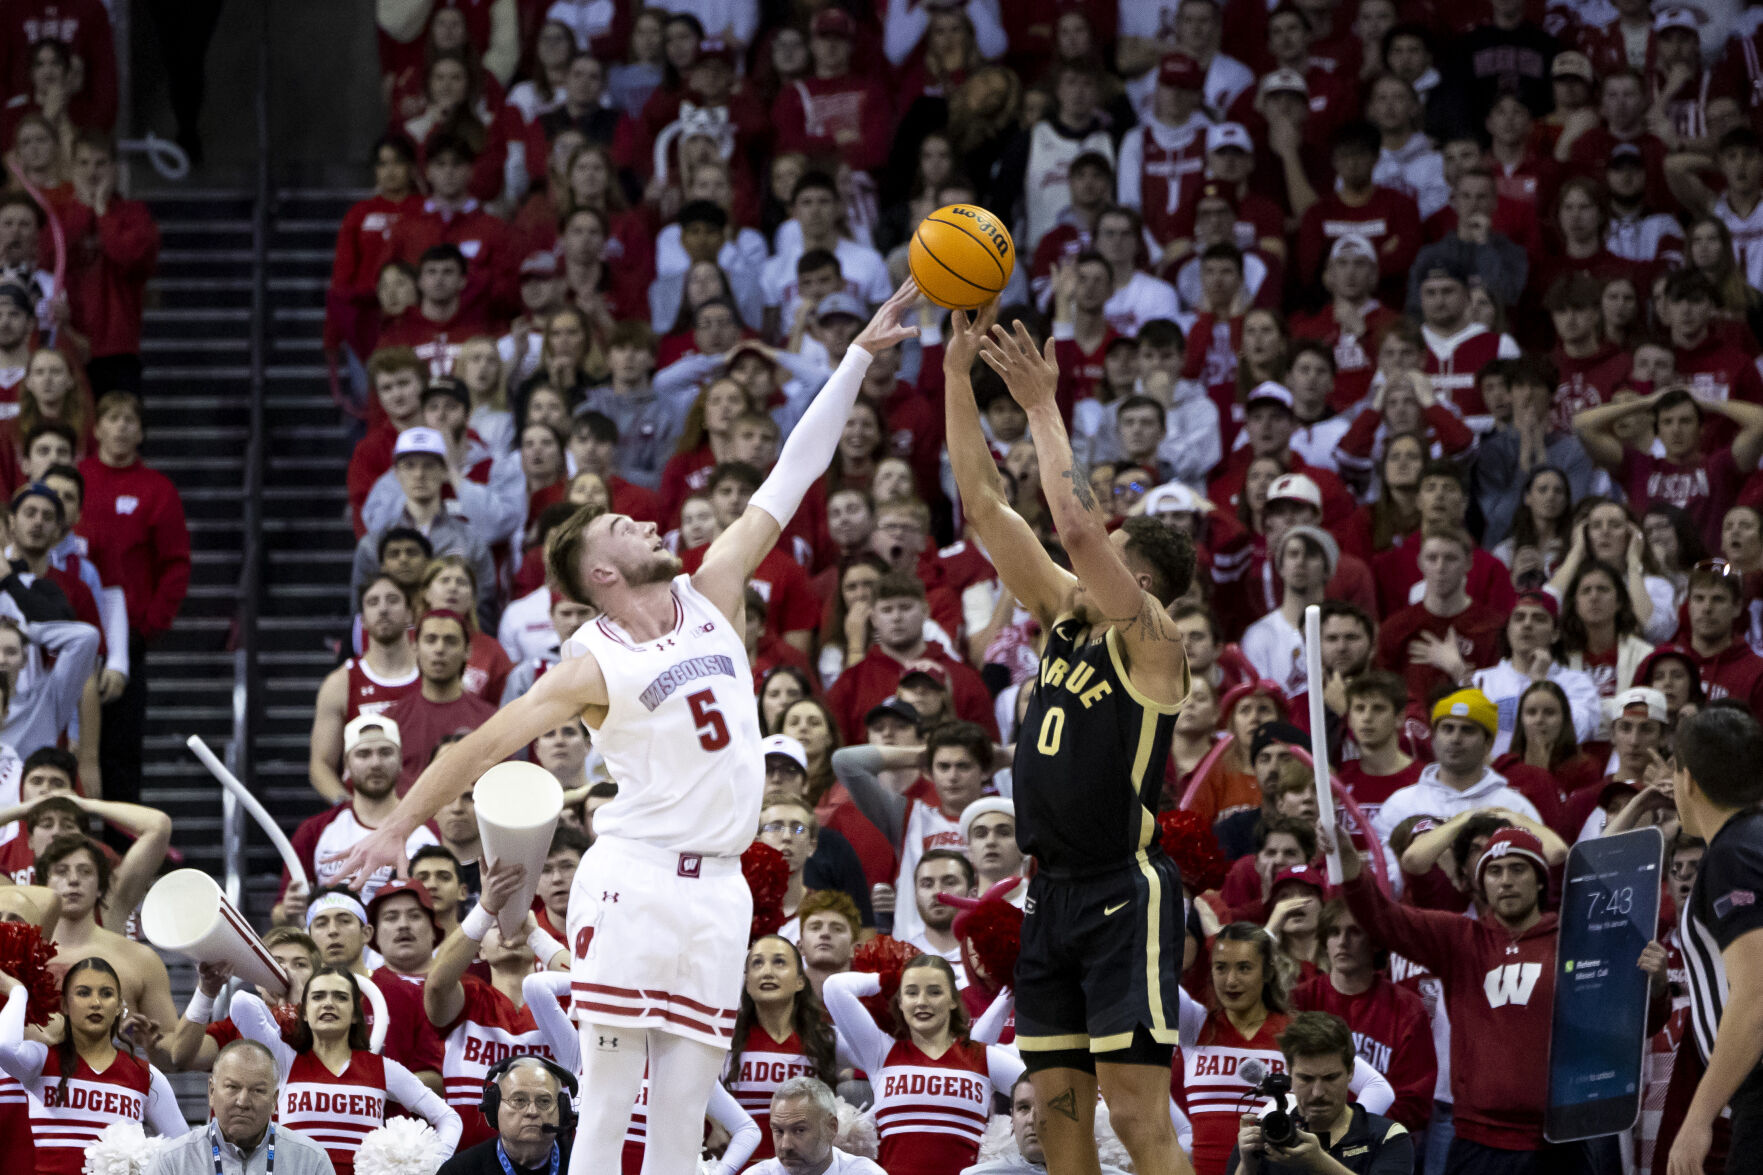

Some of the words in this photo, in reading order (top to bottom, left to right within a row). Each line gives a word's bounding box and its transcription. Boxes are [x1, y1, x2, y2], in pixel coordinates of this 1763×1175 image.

[952, 207, 1009, 259] Wilson
[638, 654, 737, 713] WISCONSIN
[685, 686, 732, 753] 5
[1037, 706, 1065, 756] 0
[1587, 887, 1633, 919] 7:43
[1483, 963, 1542, 1009] W
[44, 1085, 142, 1121] BADGERS
[287, 1091, 383, 1119] BADGERS
[884, 1074, 984, 1105] BADGERS
